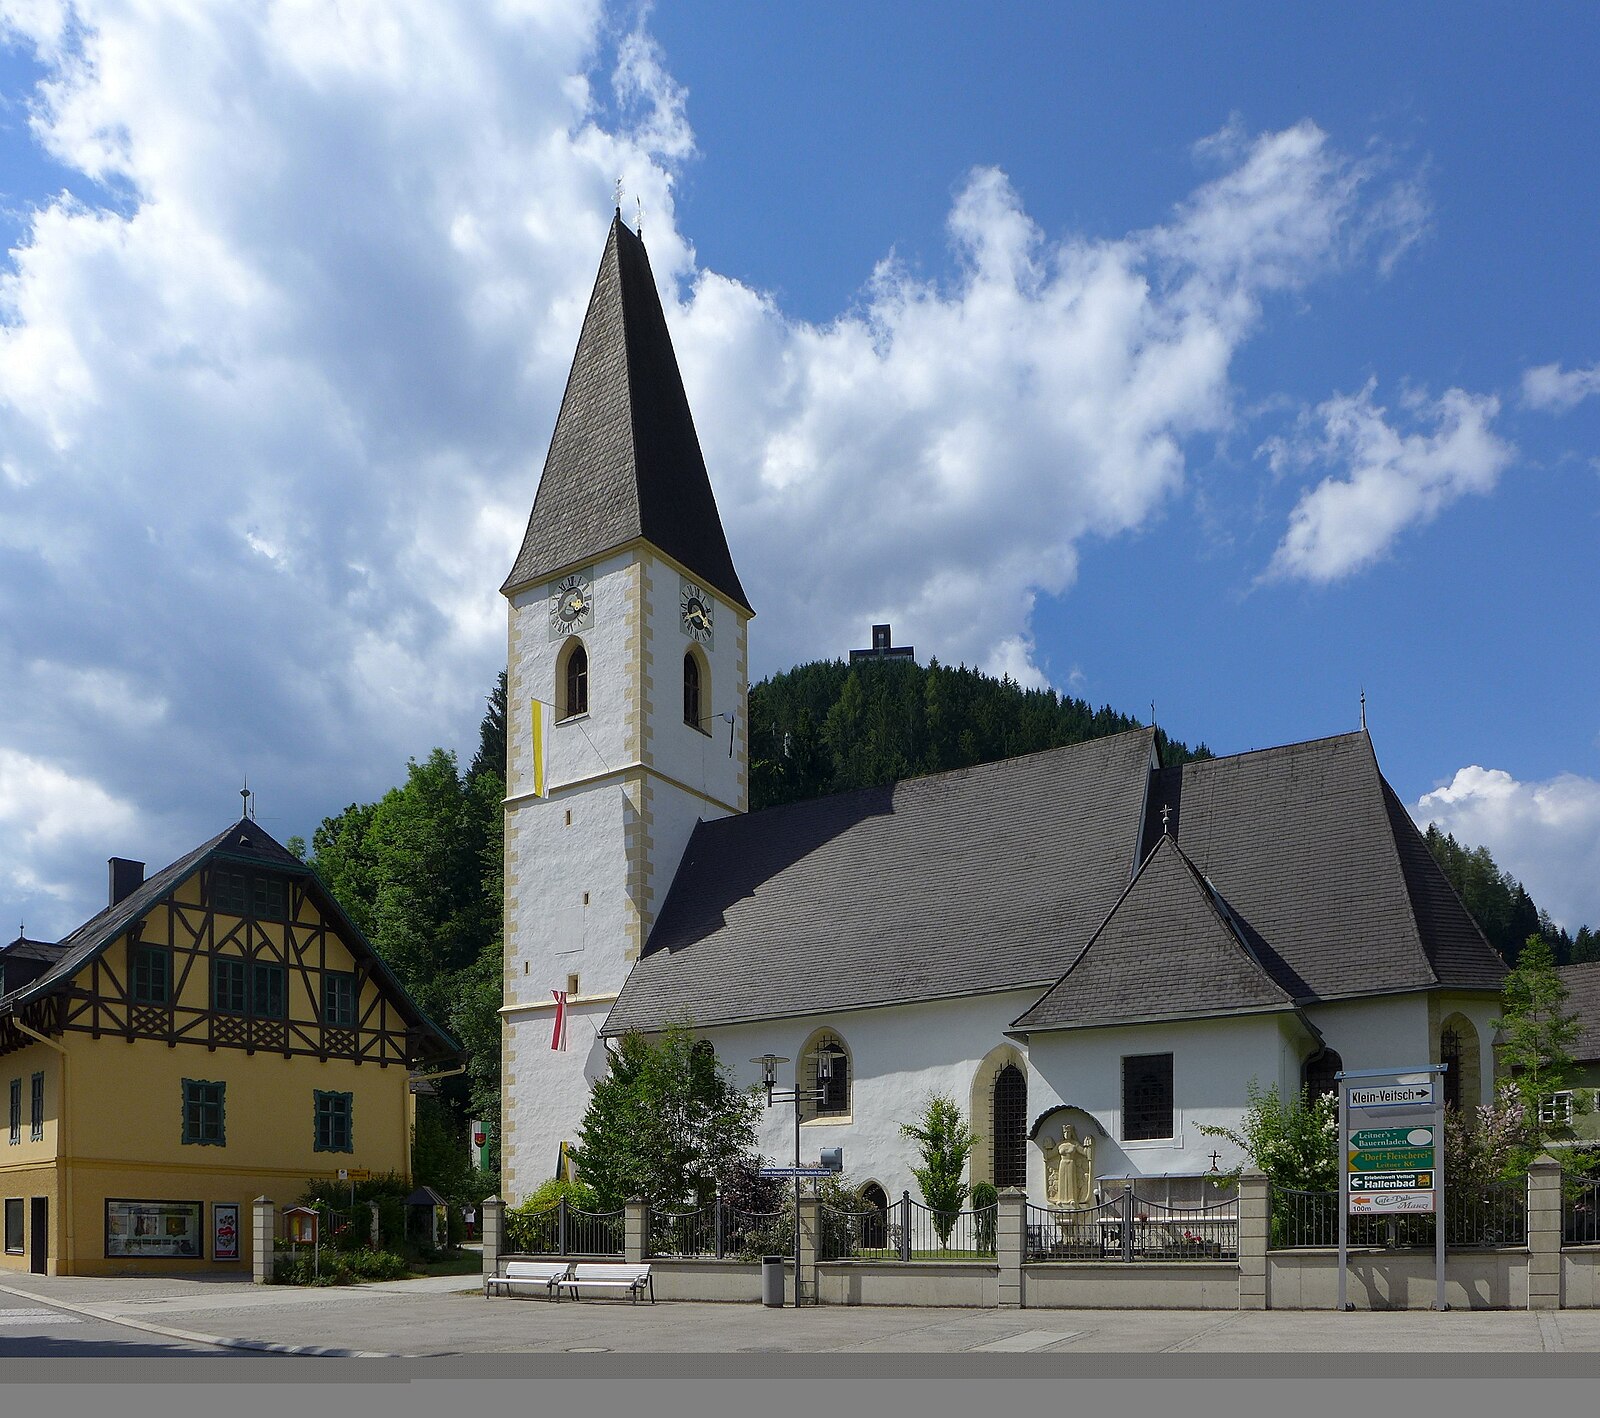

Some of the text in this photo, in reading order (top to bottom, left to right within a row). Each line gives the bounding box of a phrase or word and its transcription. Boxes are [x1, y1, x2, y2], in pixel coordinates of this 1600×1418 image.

[1352, 1089, 1414, 1103] Klein-Veitsch
[1359, 1138, 1407, 1146] Bauernladen
[1364, 1180, 1416, 1189] Hallenbad
